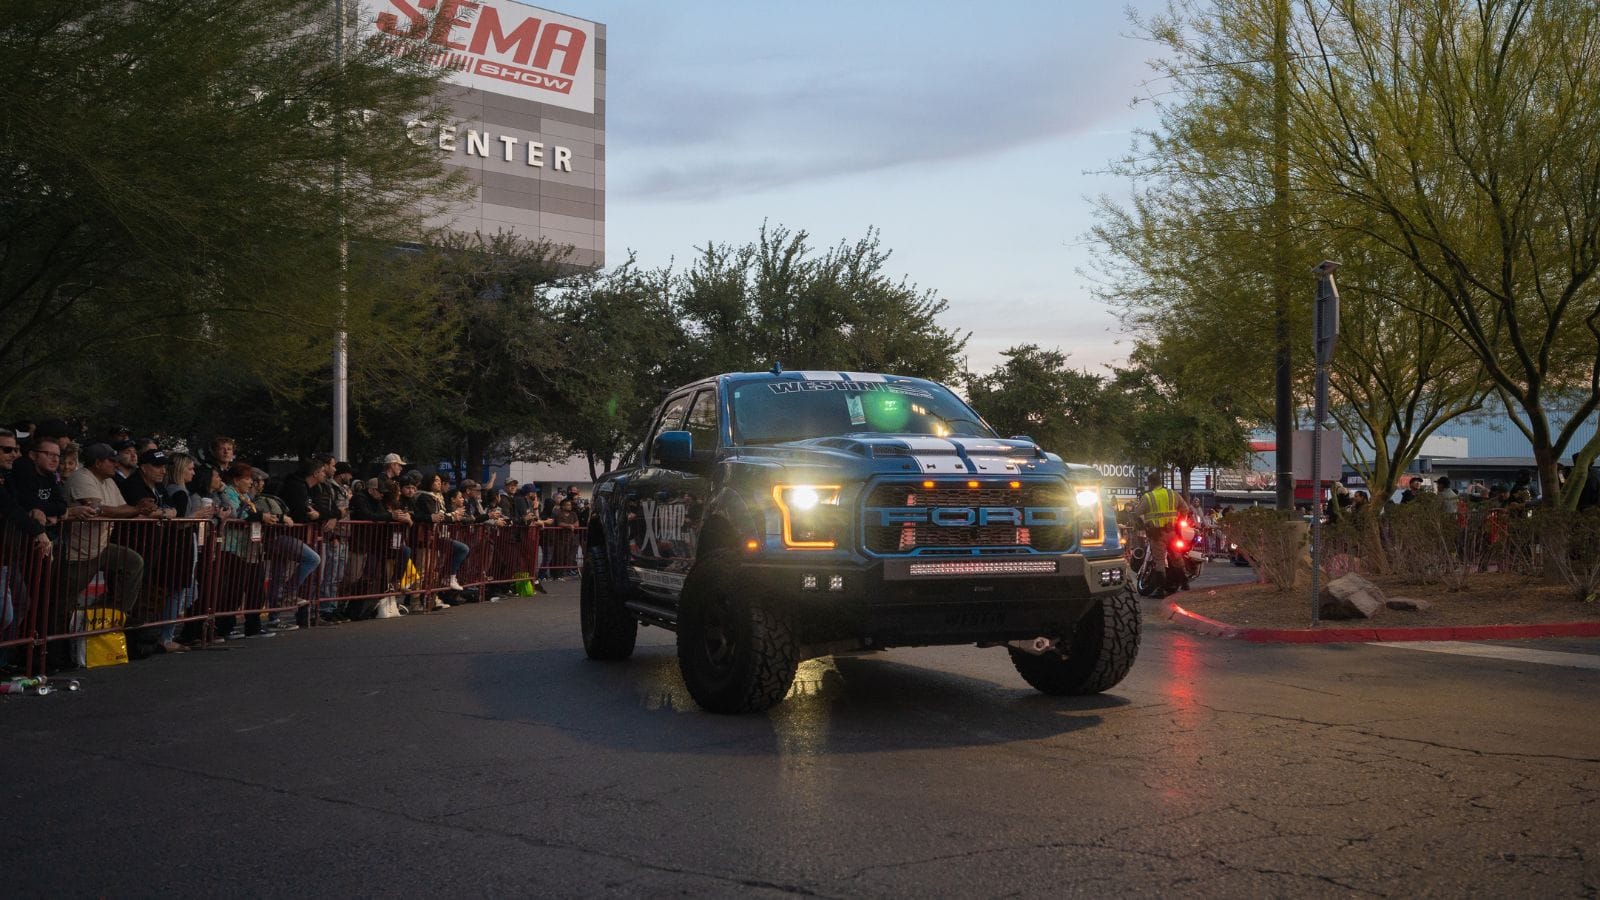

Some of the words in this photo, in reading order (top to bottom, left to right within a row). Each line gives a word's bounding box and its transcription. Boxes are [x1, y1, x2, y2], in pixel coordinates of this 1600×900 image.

[376, 0, 587, 77] SEMA
[479, 64, 569, 91] SHOW
[406, 118, 573, 172] CENTER
[1092, 463, 1136, 478] PADDOCK
[876, 507, 1067, 526] FORD
